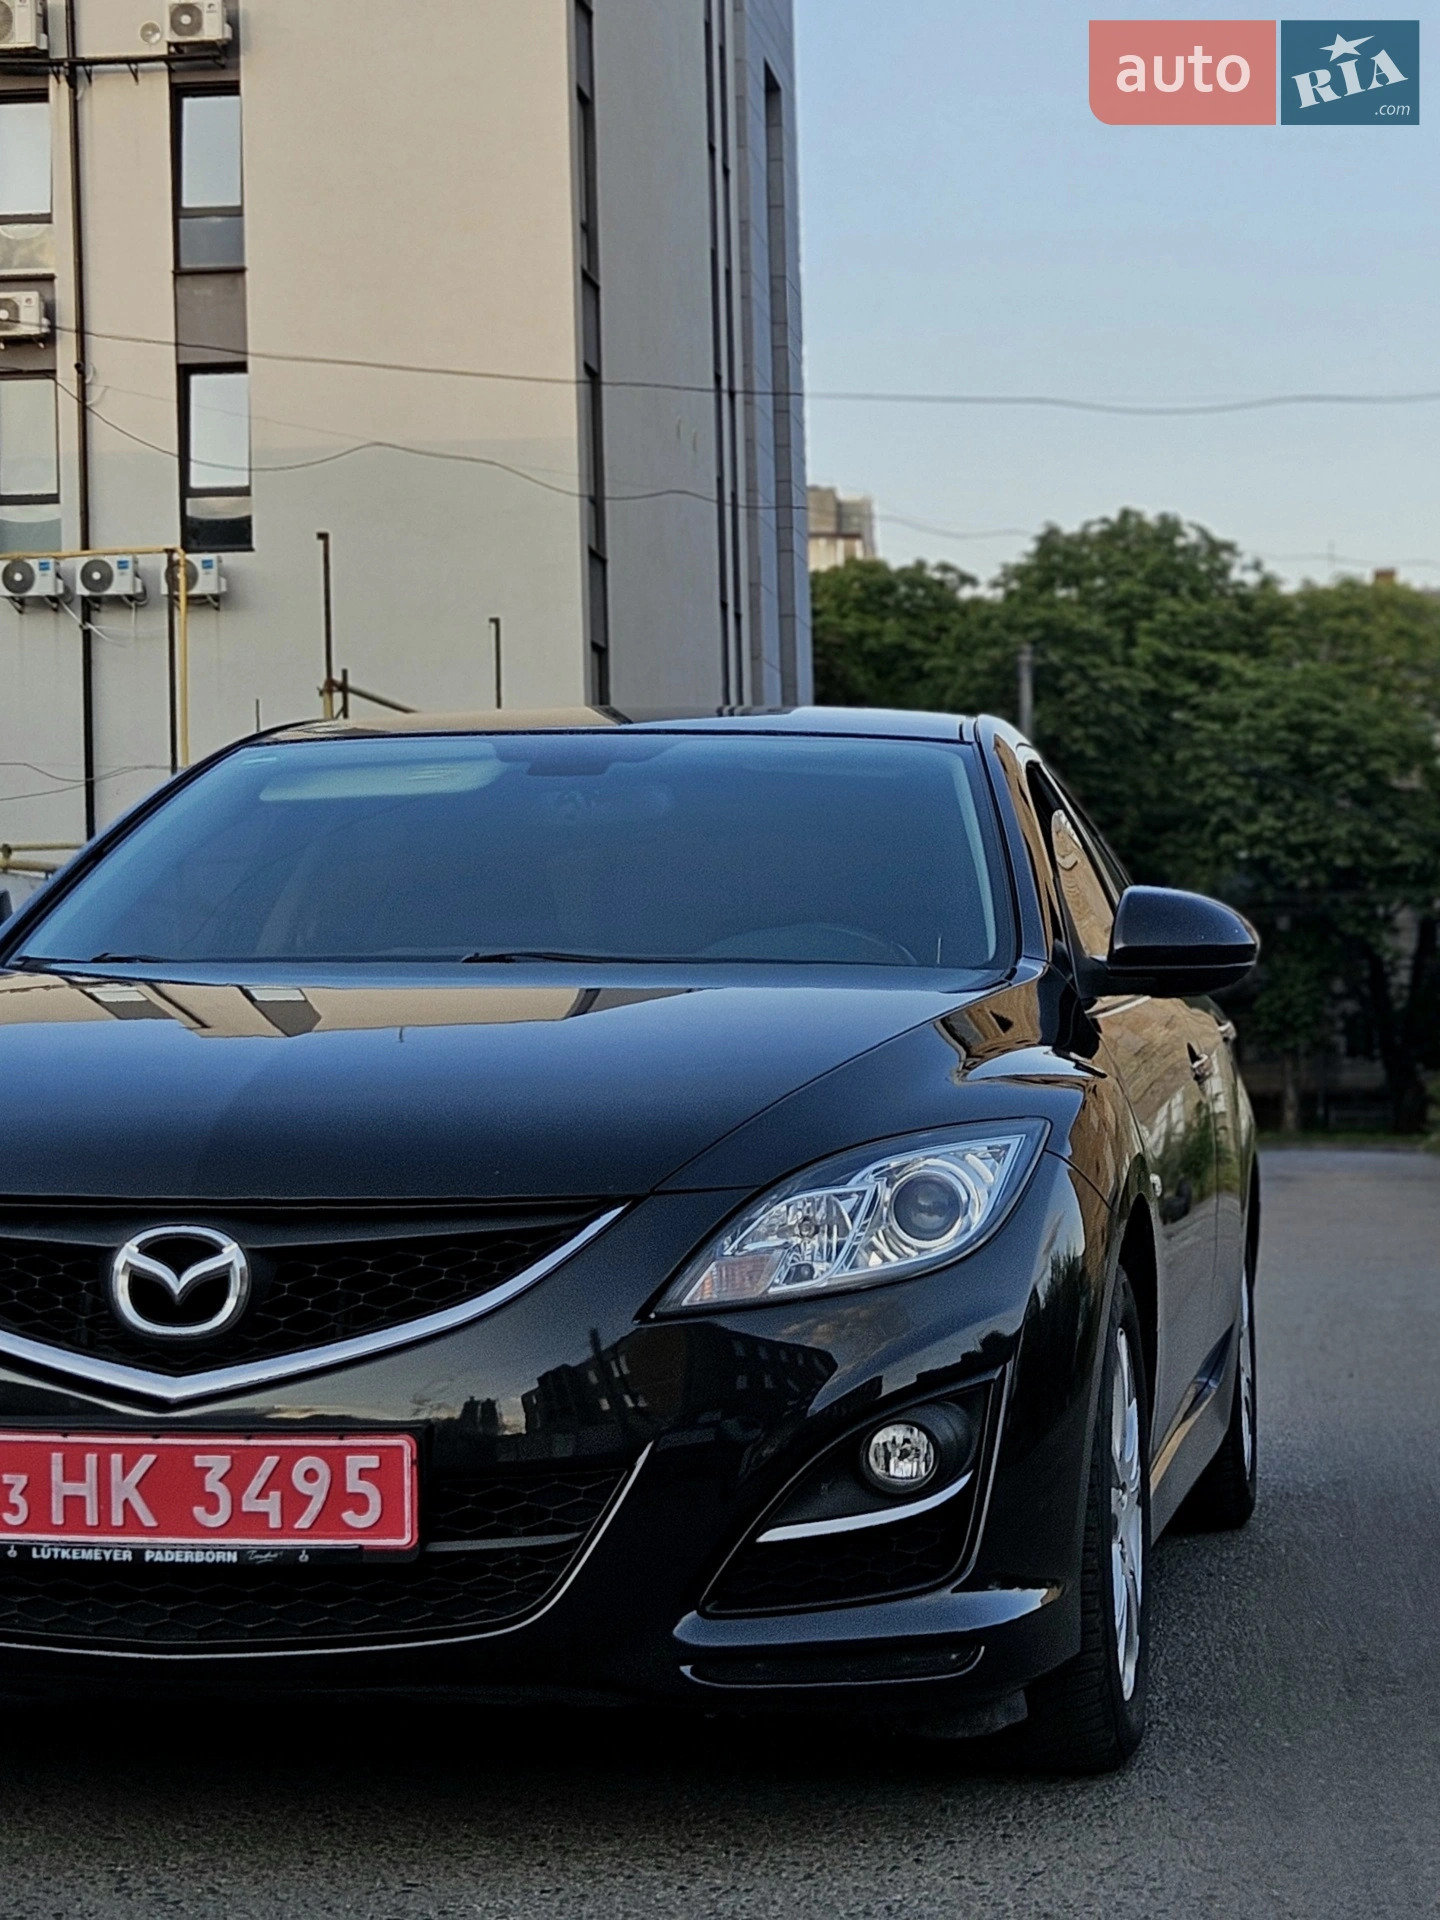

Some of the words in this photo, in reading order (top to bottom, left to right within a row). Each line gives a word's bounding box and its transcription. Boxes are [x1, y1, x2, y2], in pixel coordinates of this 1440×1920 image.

[1, 1473, 29, 1527] 3
[50, 1451, 159, 1528] HK
[191, 1454, 383, 1531] 3495
[144, 1549, 238, 1563] PADERBORN
